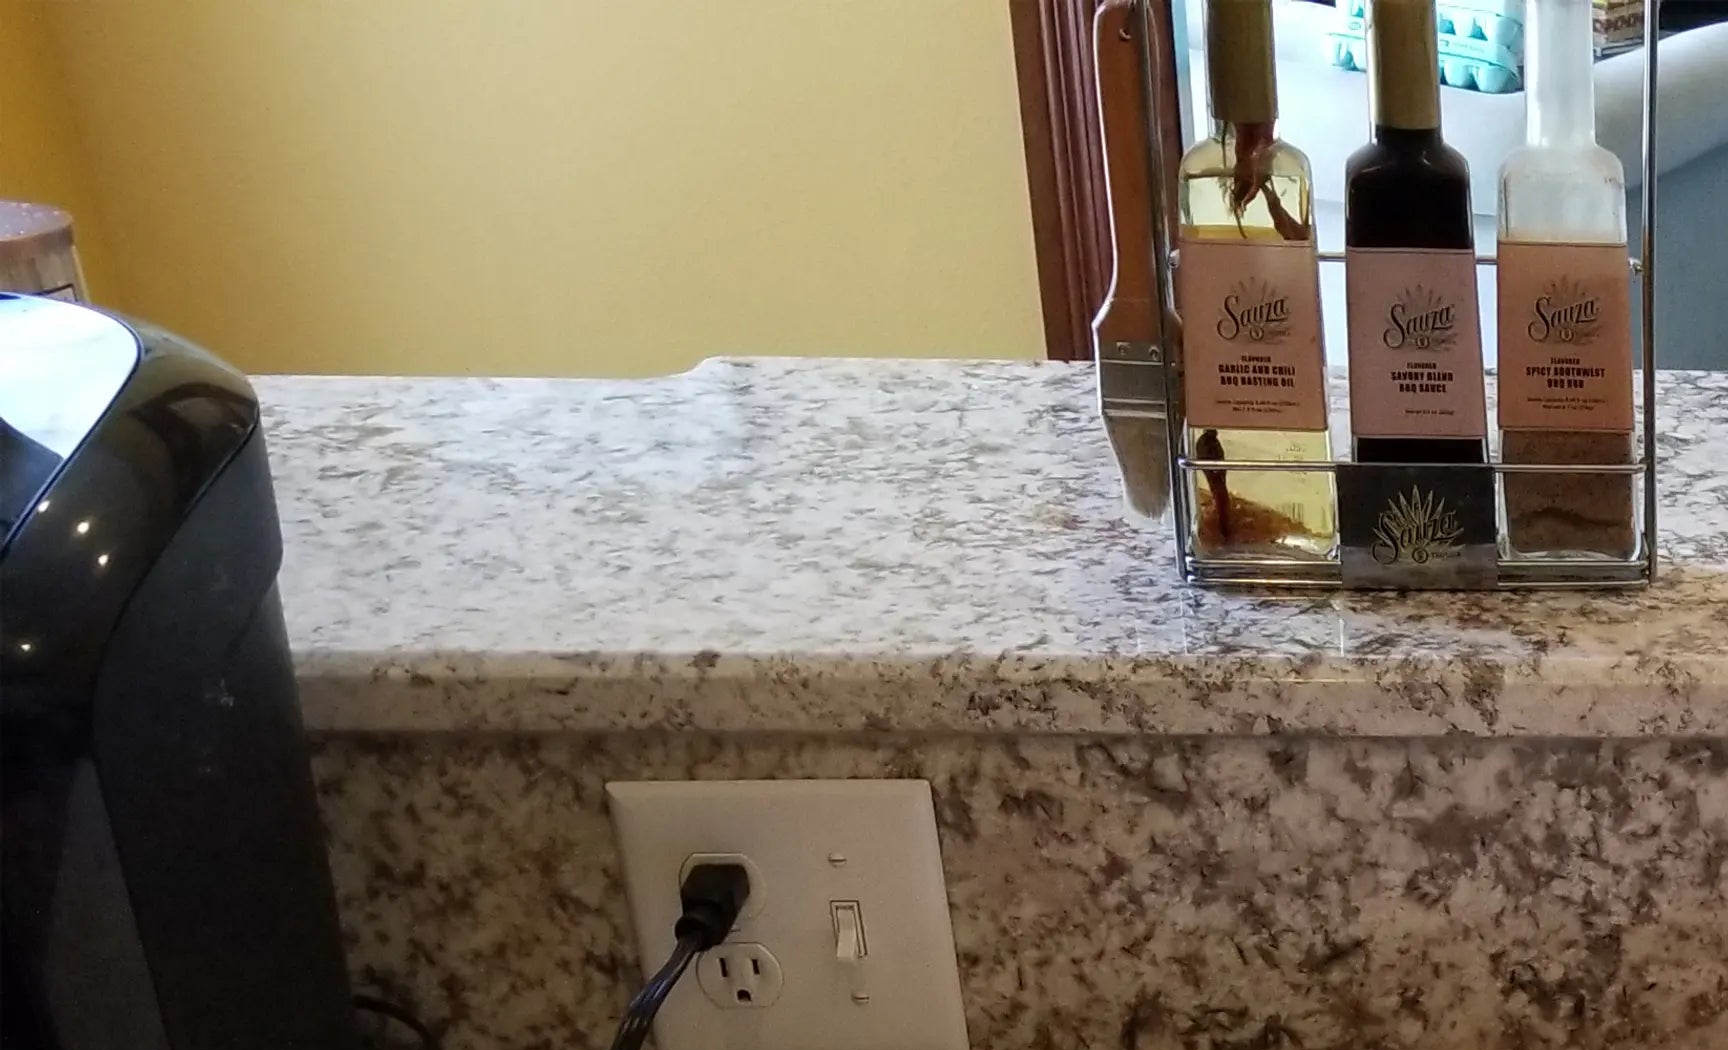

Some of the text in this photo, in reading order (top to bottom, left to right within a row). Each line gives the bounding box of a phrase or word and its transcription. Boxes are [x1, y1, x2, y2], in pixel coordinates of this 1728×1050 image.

[1217, 295, 1289, 341] Sauza
[1528, 296, 1599, 342] Sauza
[1383, 303, 1455, 349] Sauza
[1218, 364, 1296, 376] GARLIC AND CHILI
[1391, 371, 1453, 381] SAVORY BLEND
[1526, 366, 1605, 378] SPICY SOUTHWEST
[1220, 376, 1295, 387] BBQ BASTING OIL
[1399, 383, 1447, 393] BBQ SAUCE
[1372, 509, 1456, 565] Sauza
